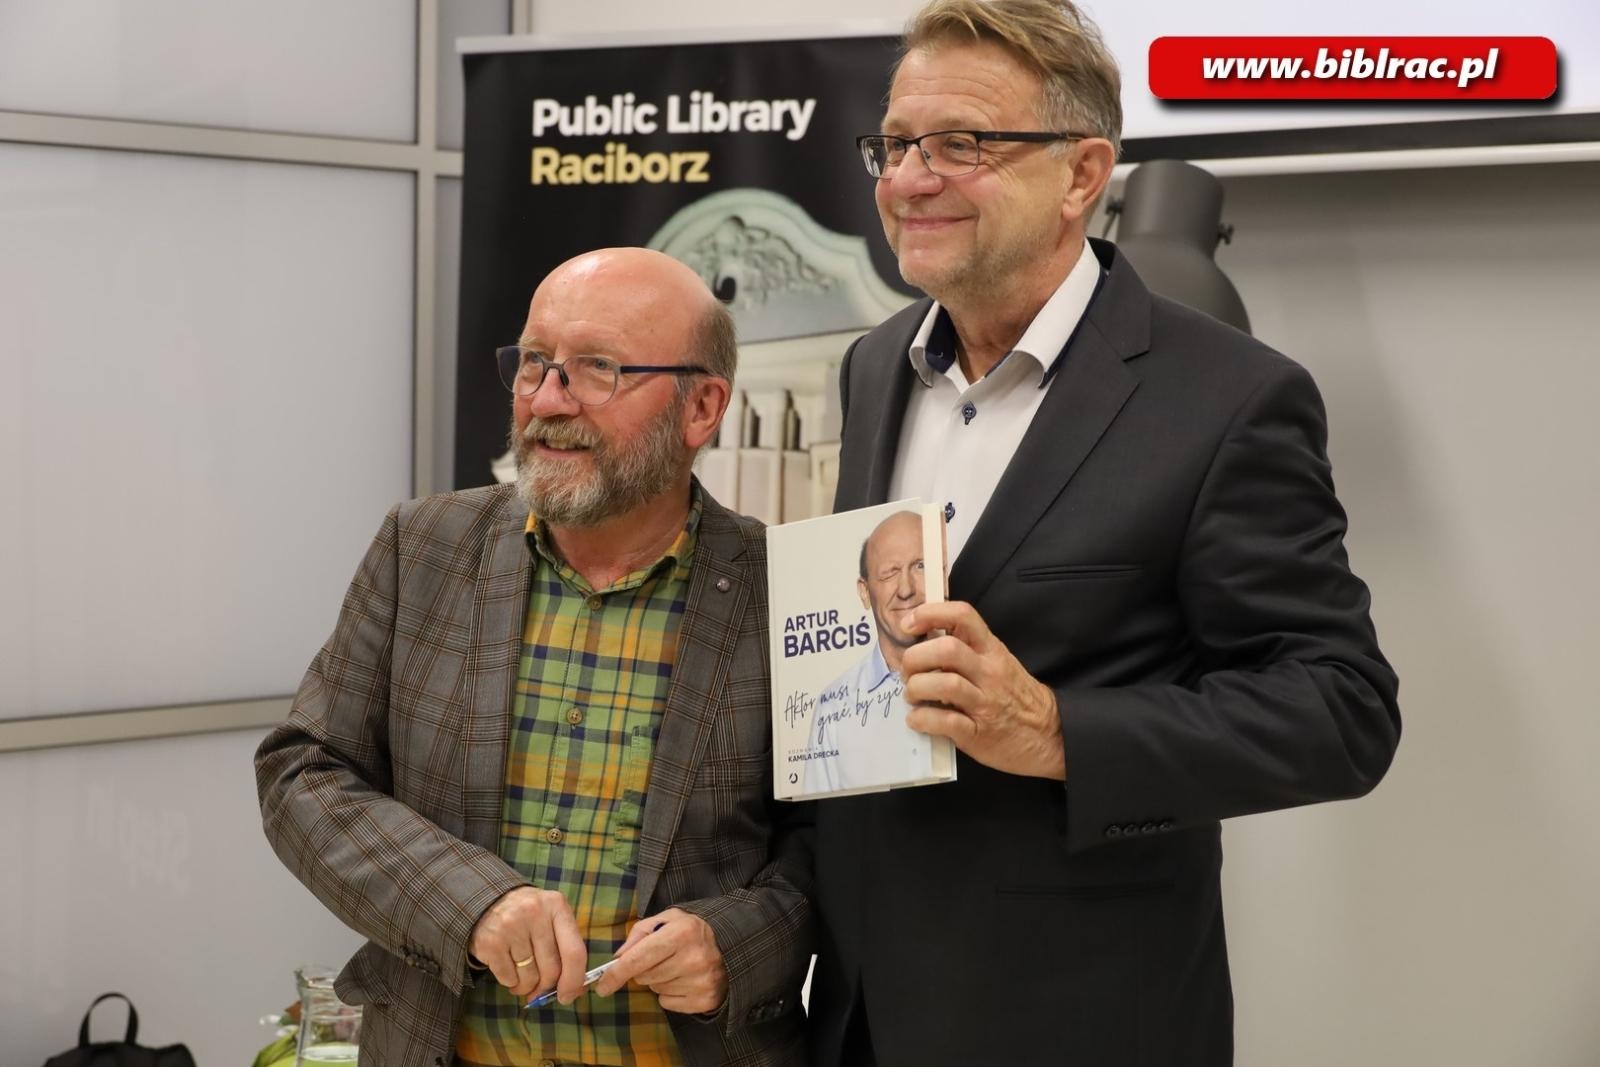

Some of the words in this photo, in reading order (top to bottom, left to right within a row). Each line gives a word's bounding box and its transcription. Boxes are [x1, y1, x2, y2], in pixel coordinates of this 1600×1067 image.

[532, 92, 658, 137] Public
[667, 90, 817, 141] Library
[531, 142, 710, 185] Raciborz
[784, 609, 839, 633] ARTUR
[784, 616, 871, 658] BARCIŚ
[784, 690, 816, 729] Aktor
[820, 683, 849, 704] musi
[856, 688, 875, 727] by
[788, 753, 812, 763] KAMILA
[813, 749, 840, 760] DRECKA
